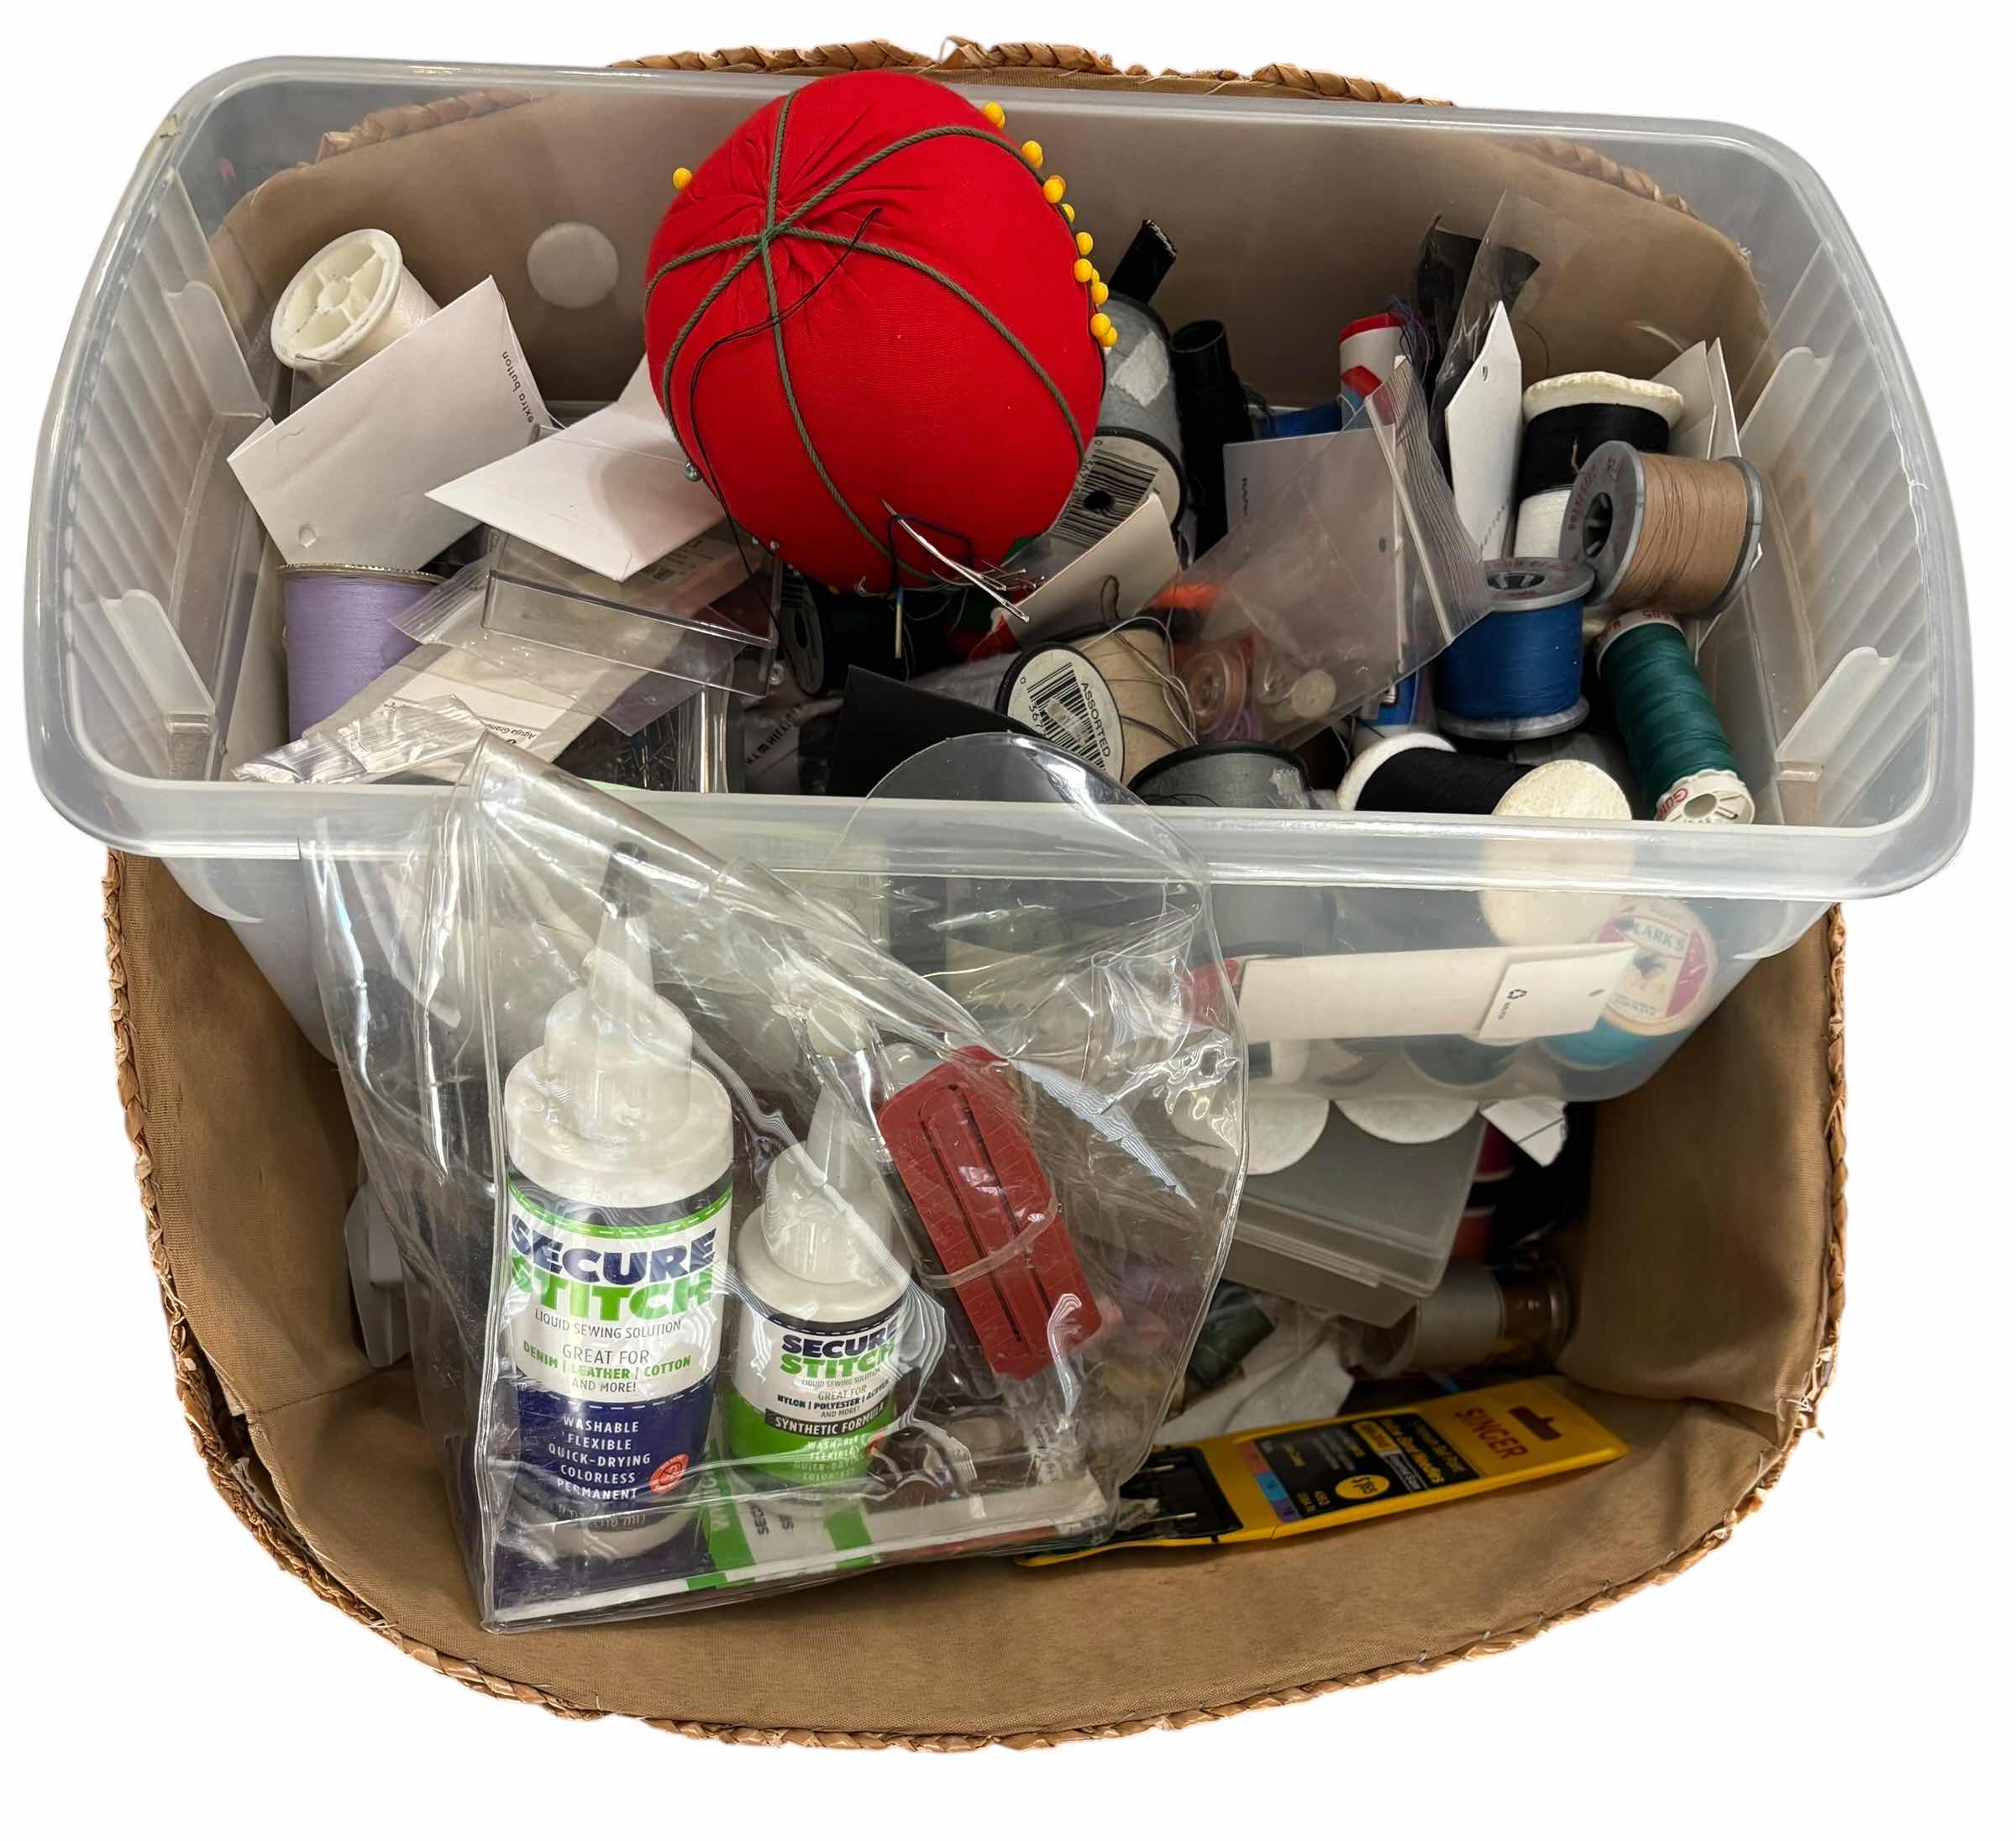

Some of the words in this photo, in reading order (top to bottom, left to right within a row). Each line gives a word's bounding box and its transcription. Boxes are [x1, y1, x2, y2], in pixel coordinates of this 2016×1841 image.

[502, 351, 521, 392] button
[518, 392, 534, 422] extra
[1080, 681, 1111, 758] ASSORTED
[511, 1213, 717, 1286] SECURE
[511, 1248, 714, 1322] STITCH
[535, 1308, 570, 1331] LIQUID
[574, 1322, 622, 1339] SEWING
[624, 1319, 682, 1339] SOLUTION
[523, 1340, 558, 1368] DENIM
[570, 1365, 630, 1379] LEATHER
[644, 1355, 691, 1378] COTTON
[562, 1343, 613, 1365] GREAT
[619, 1349, 649, 1365] FOR
[572, 1377, 596, 1392] AND
[600, 1381, 637, 1393] MORE!
[818, 1389, 849, 1401] GREAT
[850, 1385, 867, 1398] FOR
[813, 1397, 860, 1410] POLYESTER
[821, 1409, 837, 1419] AND
[564, 1414, 639, 1434] WASHABLE
[774, 1415, 838, 1435] SYNTHETIC
[1454, 1407, 1529, 1460] SINGER
[568, 1434, 632, 1450] FLEXIBLE
[548, 1442, 651, 1468] QUICK-DRYING
[560, 1463, 636, 1485] COLORLESS
[557, 1477, 638, 1500] PERMANENT
